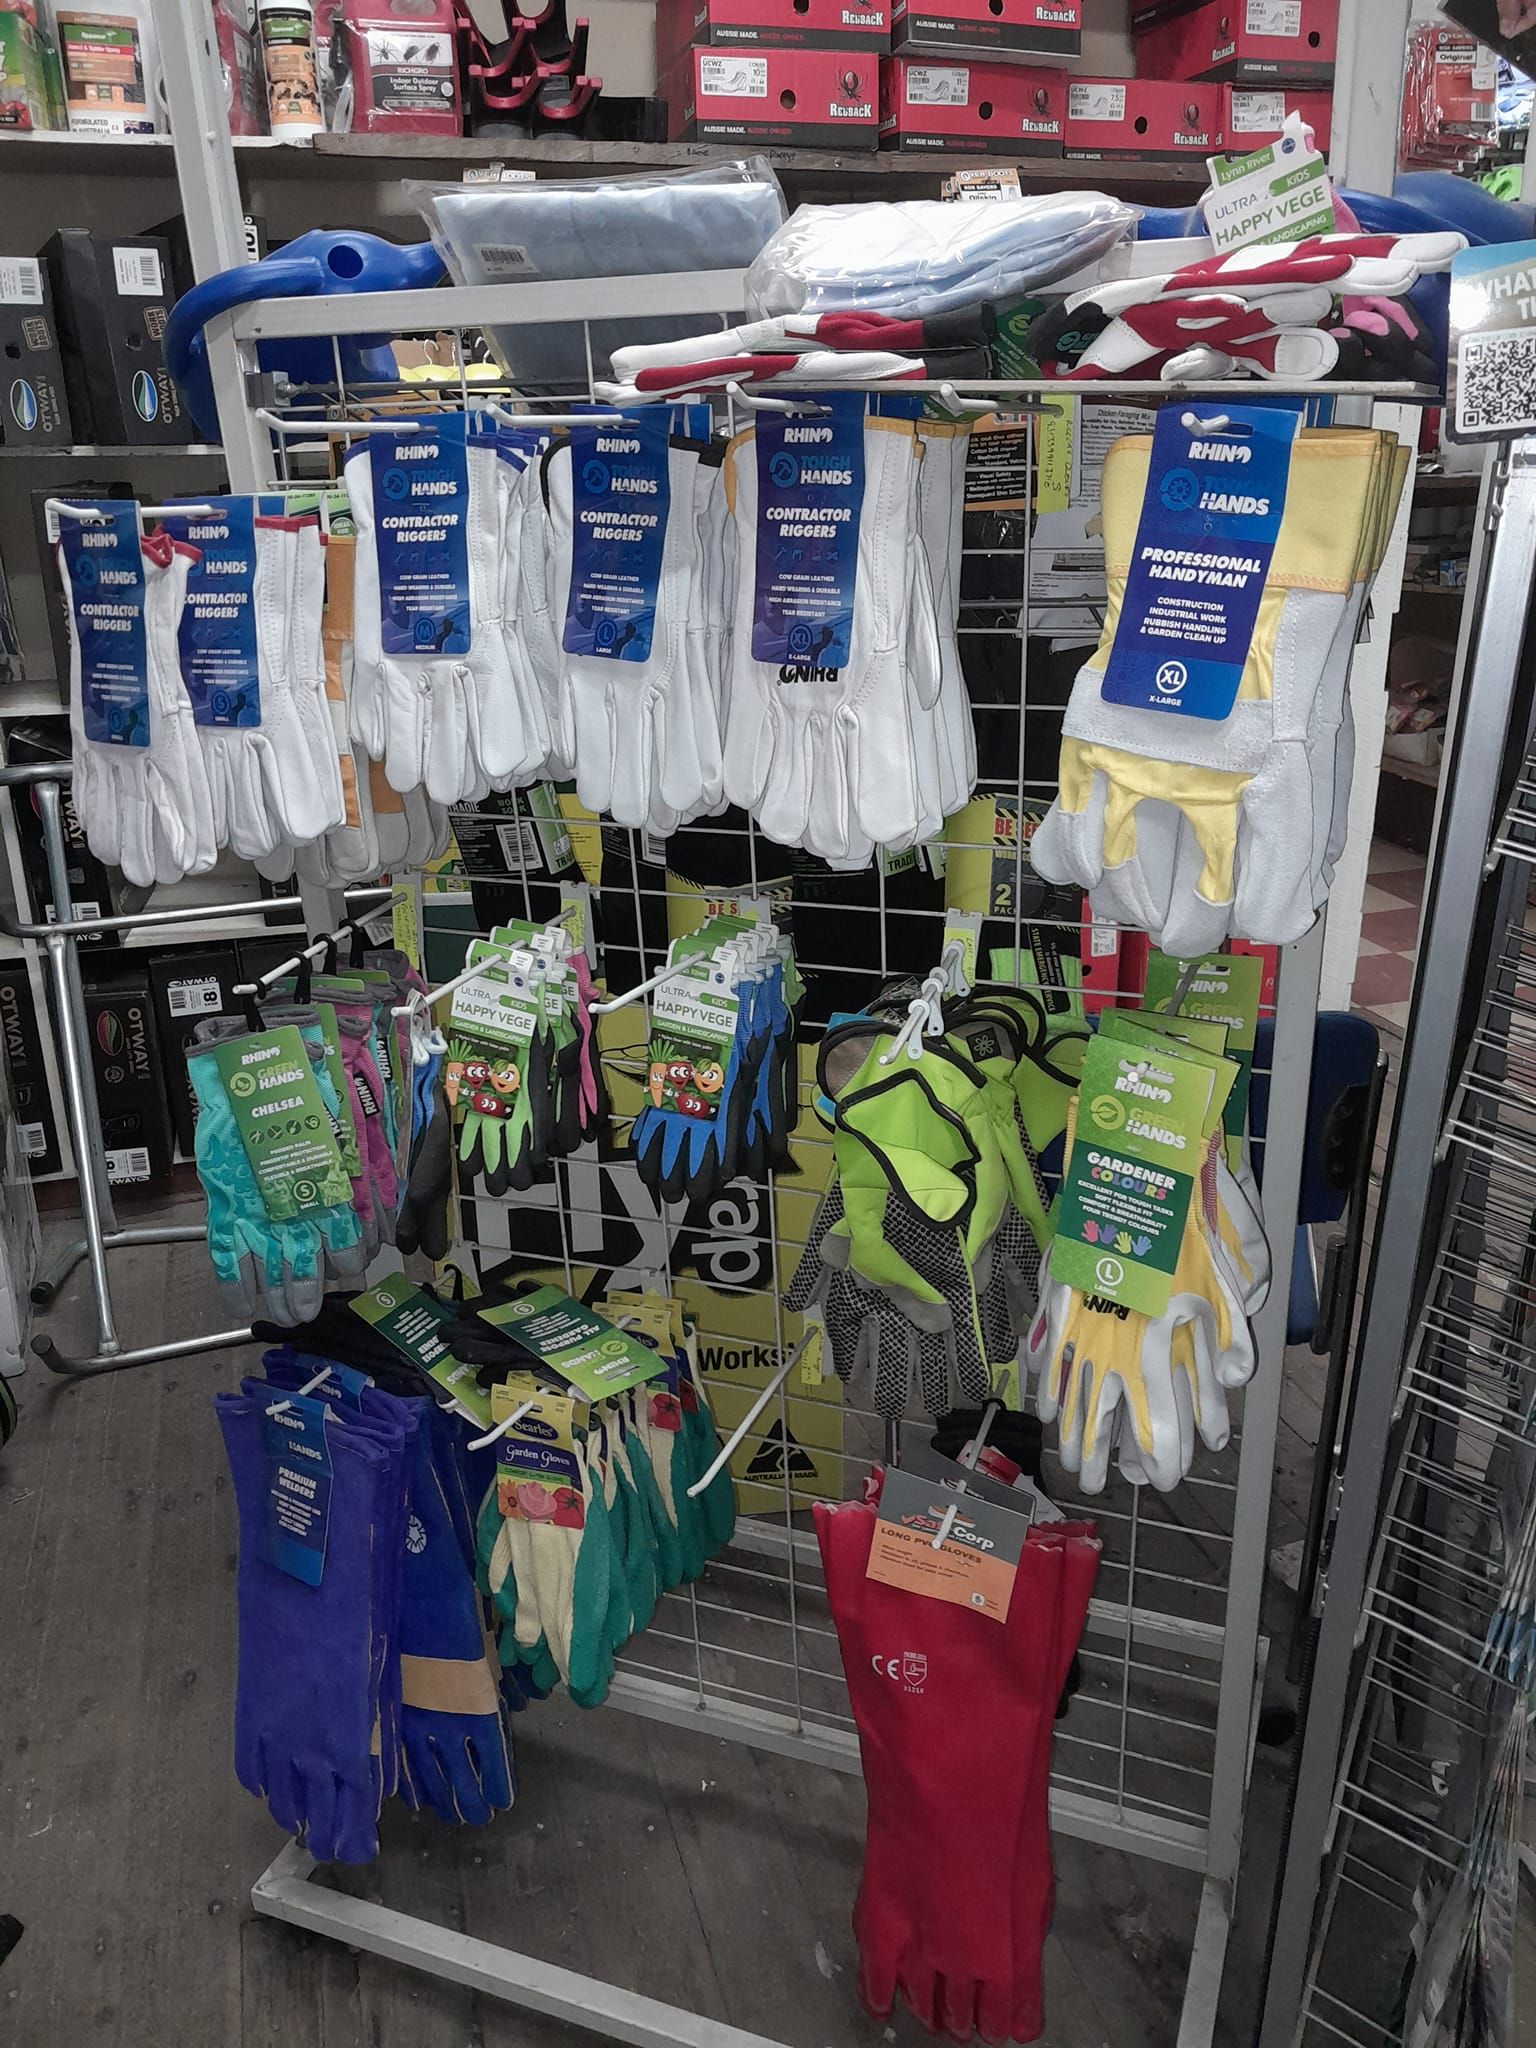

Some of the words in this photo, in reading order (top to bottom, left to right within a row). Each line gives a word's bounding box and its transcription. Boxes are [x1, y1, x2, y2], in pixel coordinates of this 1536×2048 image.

[842, 10, 884, 27] REDBACK
[1036, 6, 1076, 23] REDBACK
[916, 20, 938, 29] AUSSIE
[939, 22, 957, 30] MADE.
[716, 30, 739, 39] AUSSIE
[740, 31, 759, 40] MADE.
[1440, 52, 1474, 62] Original
[397, 66, 429, 75] RICHGRO
[1244, 64, 1262, 73] AUSSIE
[390, 77, 411, 86] Indoor
[412, 77, 440, 87] Outdoor
[393, 84, 418, 93] Surface
[419, 85, 438, 95] Spray
[829, 103, 872, 118] REDBACK
[703, 126, 725, 136] AUSSIE
[726, 127, 746, 136] MADE.
[1022, 118, 1061, 134] REDBACK
[906, 138, 927, 147] AUSSIE
[928, 139, 945, 147] MADE.
[1173, 132, 1209, 147] REDBACK
[1066, 154, 1083, 162] AUSSIE
[1220, 164, 1247, 181] Lynn
[1246, 151, 1273, 172] River
[1285, 168, 1310, 188] KIDS
[1215, 193, 1258, 220] ULTRA
[1216, 208, 1274, 247] HAPPY
[1276, 185, 1325, 219] VEGE
[146, 309, 161, 341] WORK
[157, 371, 174, 425] OTWAY
[36, 381, 54, 433] OTWAY
[784, 428, 833, 444] RHINO
[395, 445, 439, 460] RHINO
[596, 438, 641, 454] RHINO
[1188, 445, 1252, 464] RHINO
[800, 456, 850, 468] TOUGH
[611, 477, 658, 494] HANDS
[800, 468, 853, 486] HANDS
[411, 481, 457, 496] HANDS
[1199, 492, 1270, 516] HANDS
[382, 515, 459, 529] CONTRACTOR
[580, 511, 658, 528] CONTRACTOR
[766, 507, 851, 523] CONTRACTOR
[188, 526, 230, 540] RHINO
[396, 529, 447, 543] RIGGERS
[592, 527, 643, 542] RIGGERS
[779, 523, 837, 538] RIGGERS
[83, 533, 119, 548] RHINO
[206, 561, 248, 575] HANDS
[1140, 547, 1262, 577] PROFESSIONAL
[100, 571, 137, 585] HANDS
[1148, 566, 1248, 588] HANDYMAN
[184, 593, 248, 606] CONTRACTOR
[1156, 597, 1224, 612] CONSTRUCTION
[81, 604, 139, 617] CONTRACTOR
[194, 607, 239, 619] RIGGERS
[1148, 608, 1198, 621] INDUSTRIAL
[1199, 613, 1227, 624] WORK
[94, 619, 132, 632] RIGGERS
[1142, 618, 1181, 630] RUBBISH
[1181, 622, 1227, 635] HANDLING
[1139, 627, 1146, 635] &
[1146, 628, 1184, 640] GARDEN
[1184, 633, 1213, 644] CLEAN
[1212, 635, 1227, 645] UP
[788, 653, 812, 661] X-LARGE
[1161, 668, 1182, 686] XL
[1148, 695, 1182, 707] X-LARGE
[996, 884, 1012, 906] 2
[690, 969, 708, 978] River
[204, 991, 218, 1002] 8
[460, 985, 492, 1002] ULTRA
[660, 985, 693, 999] ULTRA
[711, 999, 729, 1008] KIDS
[0, 986, 27, 1058] OTWAY
[455, 1000, 498, 1021] HAPPY
[499, 1009, 533, 1031] VEGE
[656, 1000, 698, 1020] HAPPY
[700, 1009, 734, 1029] VEGE
[454, 1020, 480, 1032] GARDEN
[484, 1027, 526, 1044] LANDSCAPING
[656, 1020, 683, 1033] GARDEN
[687, 1028, 729, 1043] LANDSCAPING
[128, 1007, 150, 1074] OTWAY
[241, 1047, 281, 1065] RHINO
[376, 1040, 391, 1080] RHINO
[257, 1061, 298, 1080] GREEN
[259, 1069, 305, 1090] HANDS
[354, 1075, 376, 1115] RHINO
[1114, 1076, 1172, 1104] RHINO
[251, 1096, 304, 1118] CHELSEA
[1125, 1119, 1187, 1150] HANDS
[290, 1145, 326, 1157] PROTECTION
[1087, 1152, 1177, 1191] GARDENER
[300, 1184, 310, 1196] S
[1090, 1167, 1167, 1201] COLOURS
[300, 1201, 320, 1212] SMALL
[1077, 1179, 1113, 1196] EXCELLENT
[1113, 1191, 1127, 1201] FOR
[1127, 1195, 1153, 1209] TOUGH
[1152, 1203, 1174, 1217] TASKS
[1078, 1195, 1111, 1211] COMFORT
[1094, 1193, 1112, 1204] SOFT
[1111, 1198, 1142, 1214] FLEXIBLE
[1142, 1208, 1153, 1218] FIT
[1082, 1205, 1102, 1218] FOUR
[1101, 1211, 1128, 1225] TRENDY
[1127, 1219, 1160, 1236] COLOURS
[1104, 1262, 1114, 1279] L
[1094, 1283, 1118, 1297] LARGE
[382, 1296, 391, 1305] S
[540, 1325, 590, 1346] GARDENER
[583, 1325, 601, 1337] ALL
[540, 1333, 583, 1352] PURPOSE
[561, 1350, 601, 1368] HANDS
[593, 1357, 630, 1376] RHINO
[274, 1414, 305, 1431] RHINO
[516, 1419, 552, 1437] Searles
[289, 1441, 322, 1461] HANDS
[506, 1444, 539, 1462] Garden
[541, 1451, 571, 1468] Gloves
[279, 1466, 317, 1490] PREMIUM
[280, 1477, 315, 1500] WELDERS
[881, 1527, 911, 1544] LONG
[940, 1544, 982, 1564] GLOVES
[954, 1526, 994, 1554] Corp
